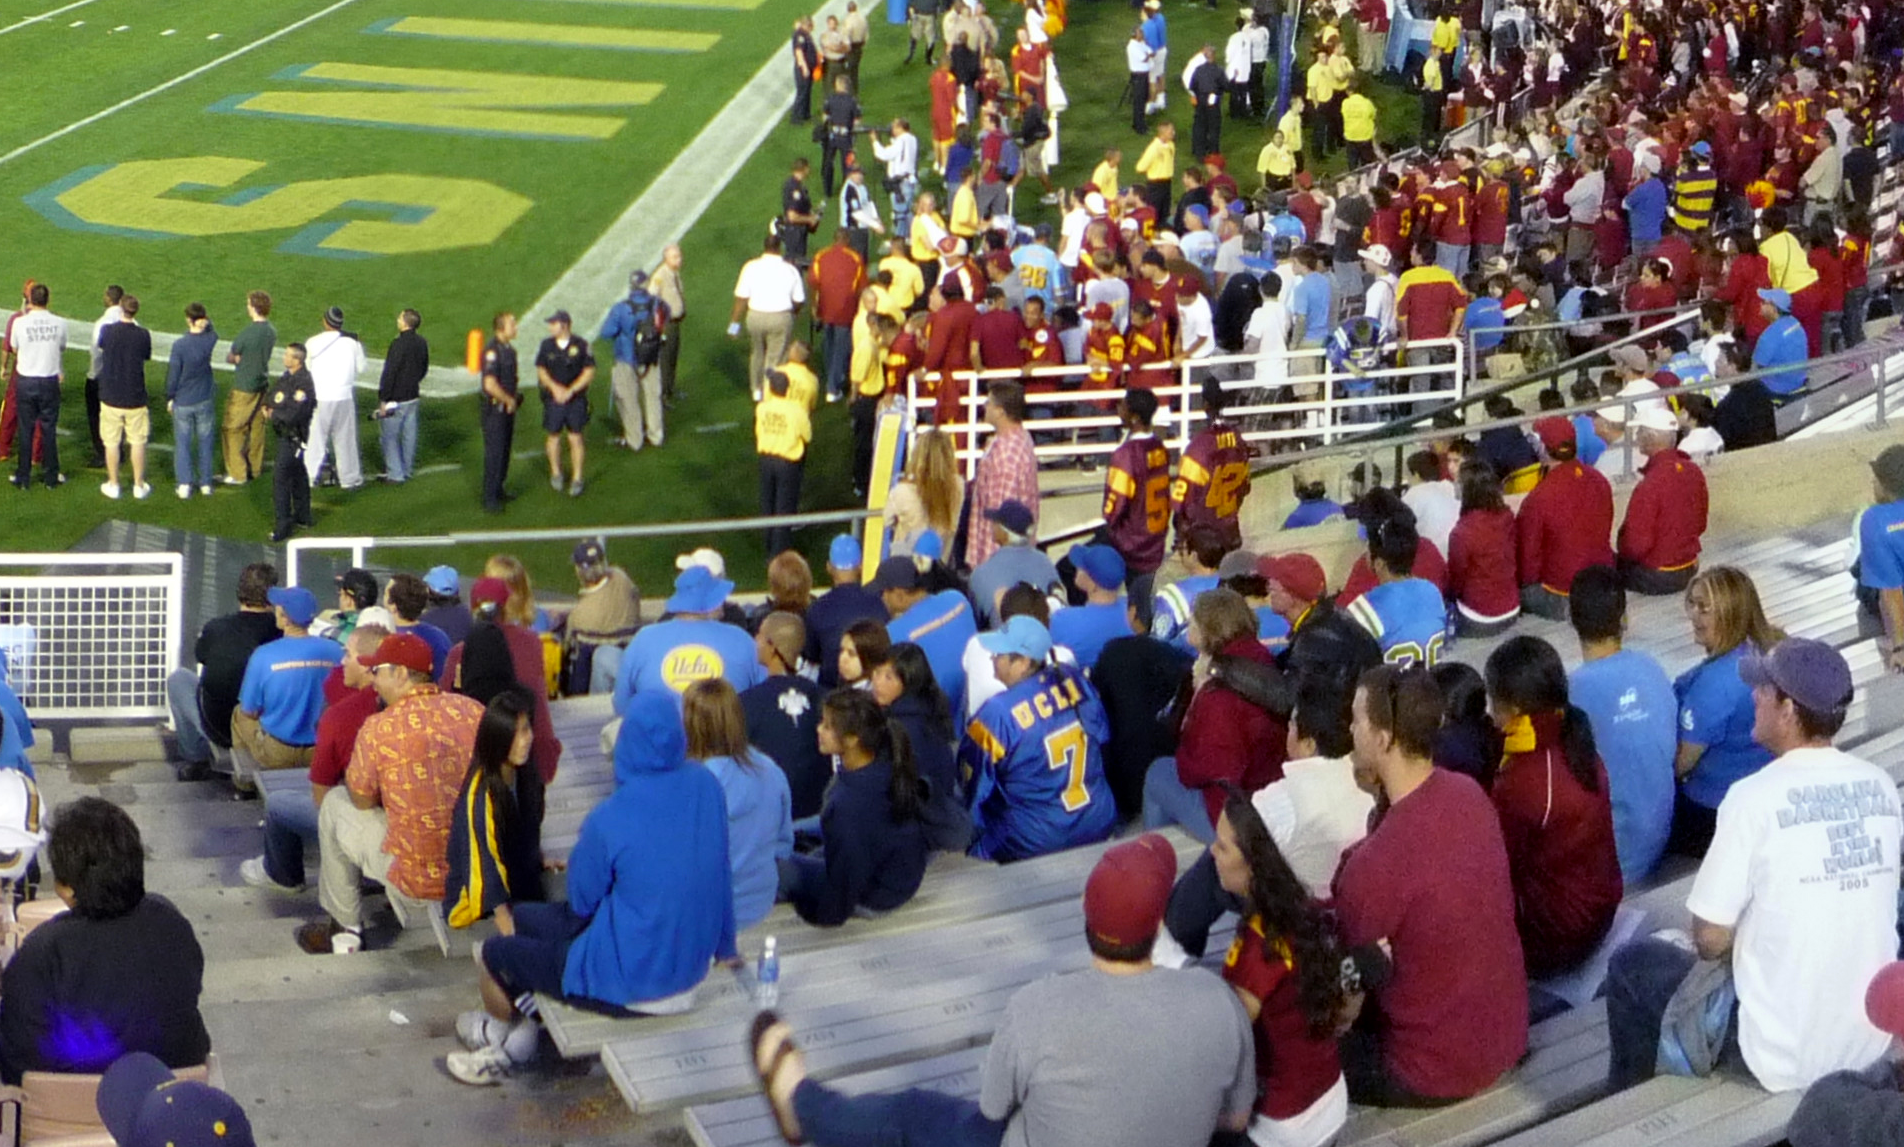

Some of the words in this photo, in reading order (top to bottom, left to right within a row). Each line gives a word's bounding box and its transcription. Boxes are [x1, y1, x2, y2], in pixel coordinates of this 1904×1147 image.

[26, 325, 59, 336] EVENT
[27, 334, 59, 344] STAFF
[1204, 460, 1250, 519] 42
[1145, 476, 1170, 534] 5
[1044, 719, 1093, 814] 7
[1785, 779, 1885, 808] CAROLINA
[1775, 802, 1902, 830] BASKETBALL
[1839, 875, 1870, 892] 2005
